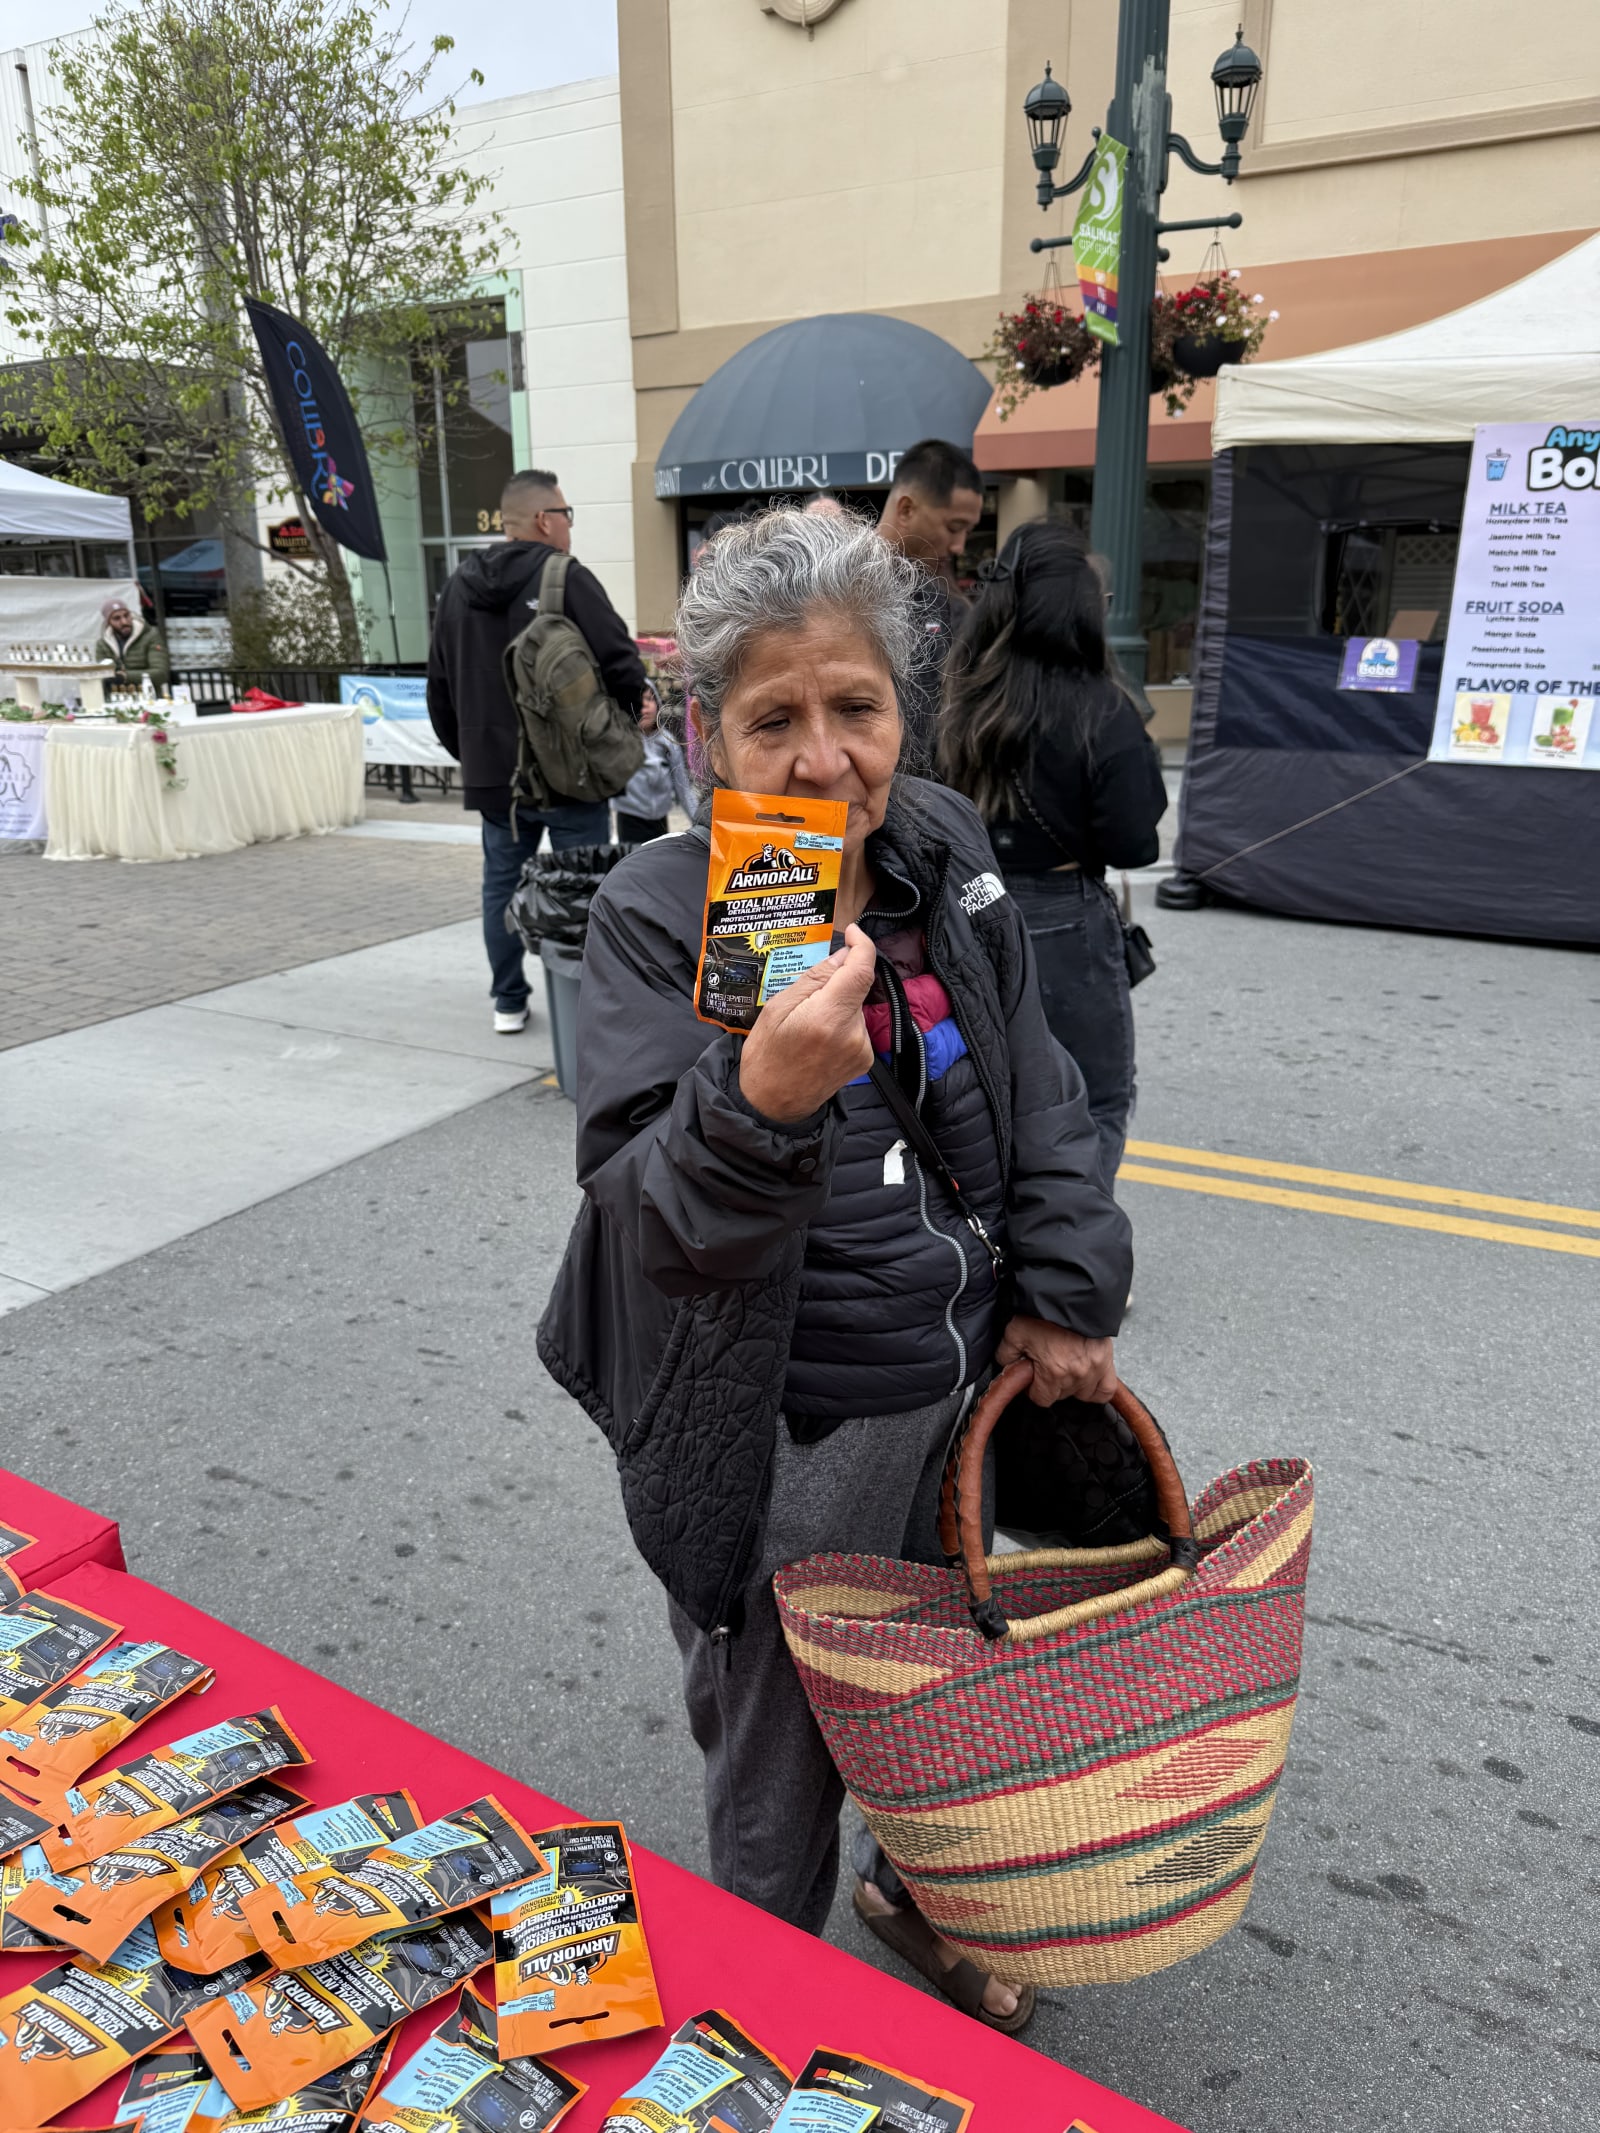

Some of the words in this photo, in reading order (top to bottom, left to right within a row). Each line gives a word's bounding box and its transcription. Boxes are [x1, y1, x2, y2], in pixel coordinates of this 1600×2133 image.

[719, 455, 831, 491] COLIBRI
[1528, 447, 1600, 490] Bo
[1490, 502, 1529, 515] MILK
[1536, 502, 1567, 515] TEA
[1533, 517, 1551, 525] Milk
[1554, 517, 1568, 525] Tea
[1488, 533, 1523, 541] Jasmine
[1488, 549, 1519, 557] Matcha
[1465, 601, 1514, 613] FRUIT
[1518, 601, 1564, 614] SODA
[1486, 615, 1515, 623] Lychee
[1518, 615, 1540, 623] Soda
[1484, 631, 1512, 639] Mango
[1455, 677, 1530, 692] FLAVOR
[1535, 680, 1562, 694] OF
[1567, 681, 1600, 695] THE
[731, 866, 814, 889] ARMORALL
[962, 876, 984, 893] THE
[726, 899, 760, 910] TOTAL
[762, 892, 815, 907] INTERIOR
[728, 907, 761, 915] DETAILER
[766, 902, 811, 912] PROTECTANT
[966, 893, 993, 916] FACE
[720, 913, 765, 923] PROTECTEUR
[773, 908, 817, 918] TRAITEMENT
[762, 937, 796, 946] PROTECTION
[772, 931, 806, 940] PROTECTION
[578, 1915, 615, 1932] TOTAL
[519, 1924, 576, 1954] INTERIOR
[524, 1936, 614, 1977] ARMORALL
[340, 1980, 372, 2006] DETAILER
[345, 1972, 386, 2007] PROTECTEUR
[46, 1986, 96, 2016] INTERIOR
[334, 1986, 367, 2013] TOTAL
[20, 2002, 97, 2057] ARMORALL
[88, 2012, 123, 2037] TOTAL
[768, 2085, 782, 2098] 20.3
